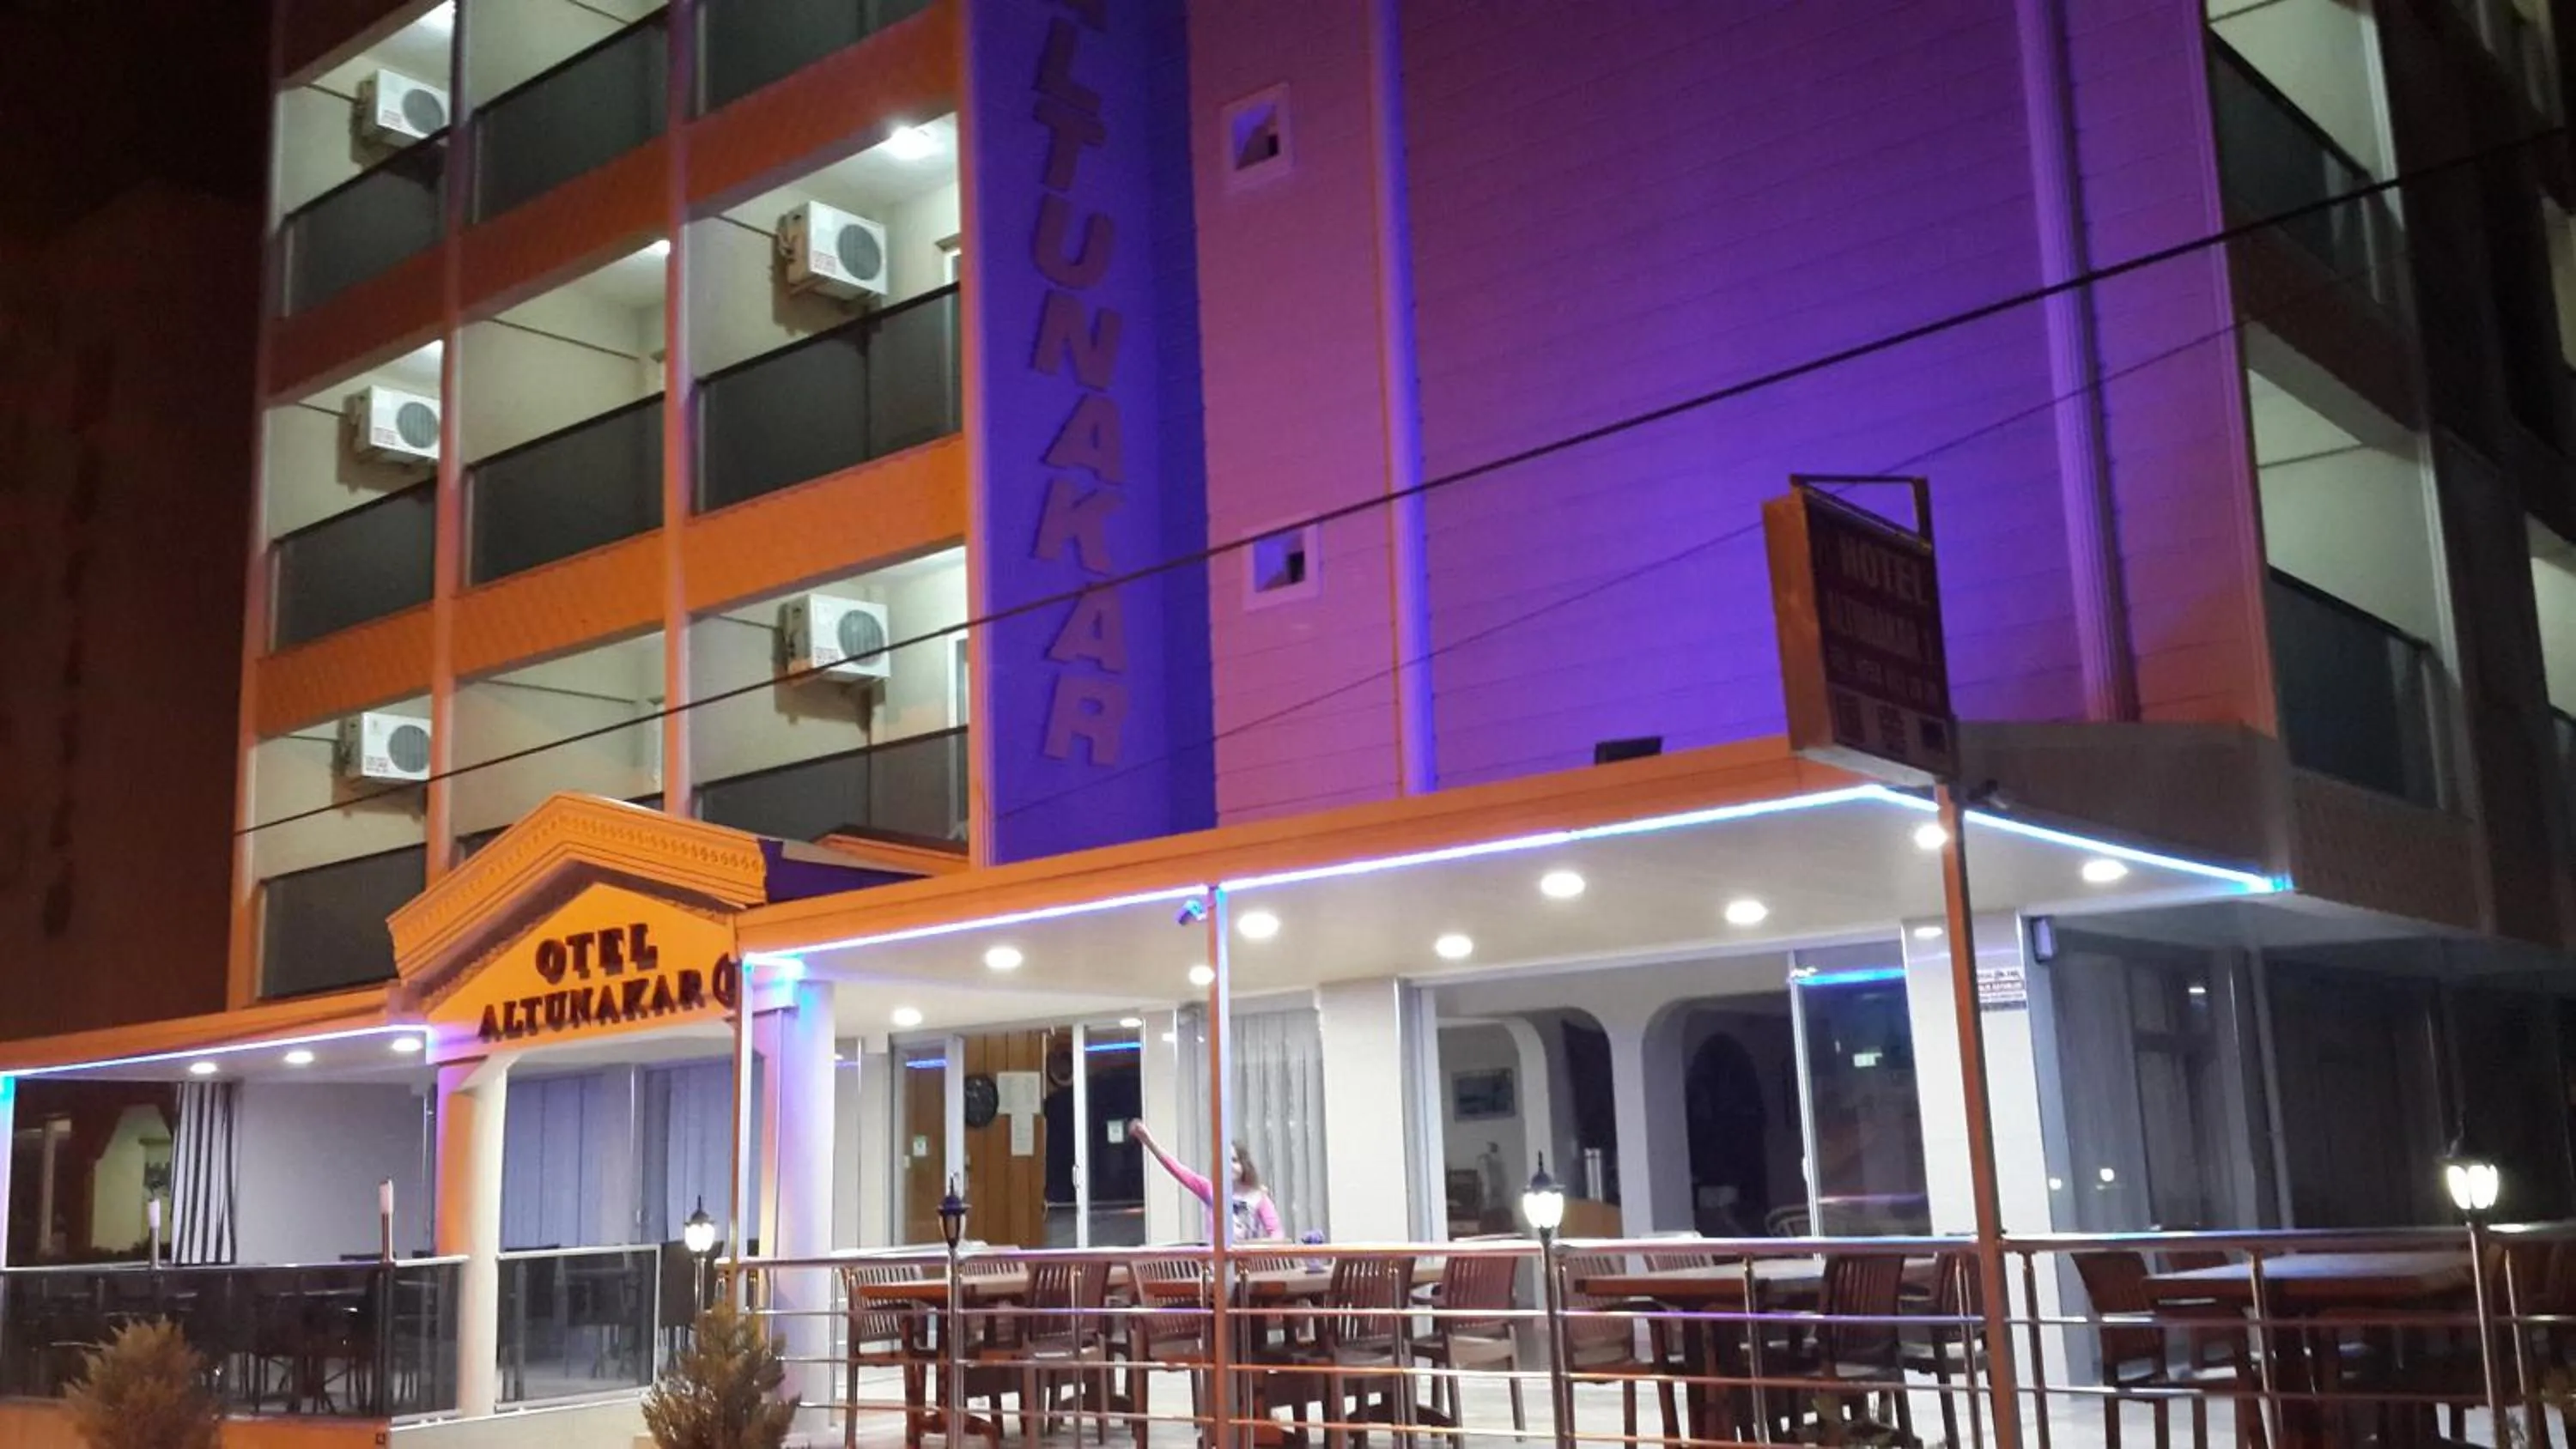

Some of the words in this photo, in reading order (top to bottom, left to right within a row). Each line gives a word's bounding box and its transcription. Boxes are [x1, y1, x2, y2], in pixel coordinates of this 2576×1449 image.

[1030, 0, 1130, 768] LTUNAKAR
[535, 923, 659, 985] OTEL
[477, 968, 706, 1041] ALTUNAKAR
